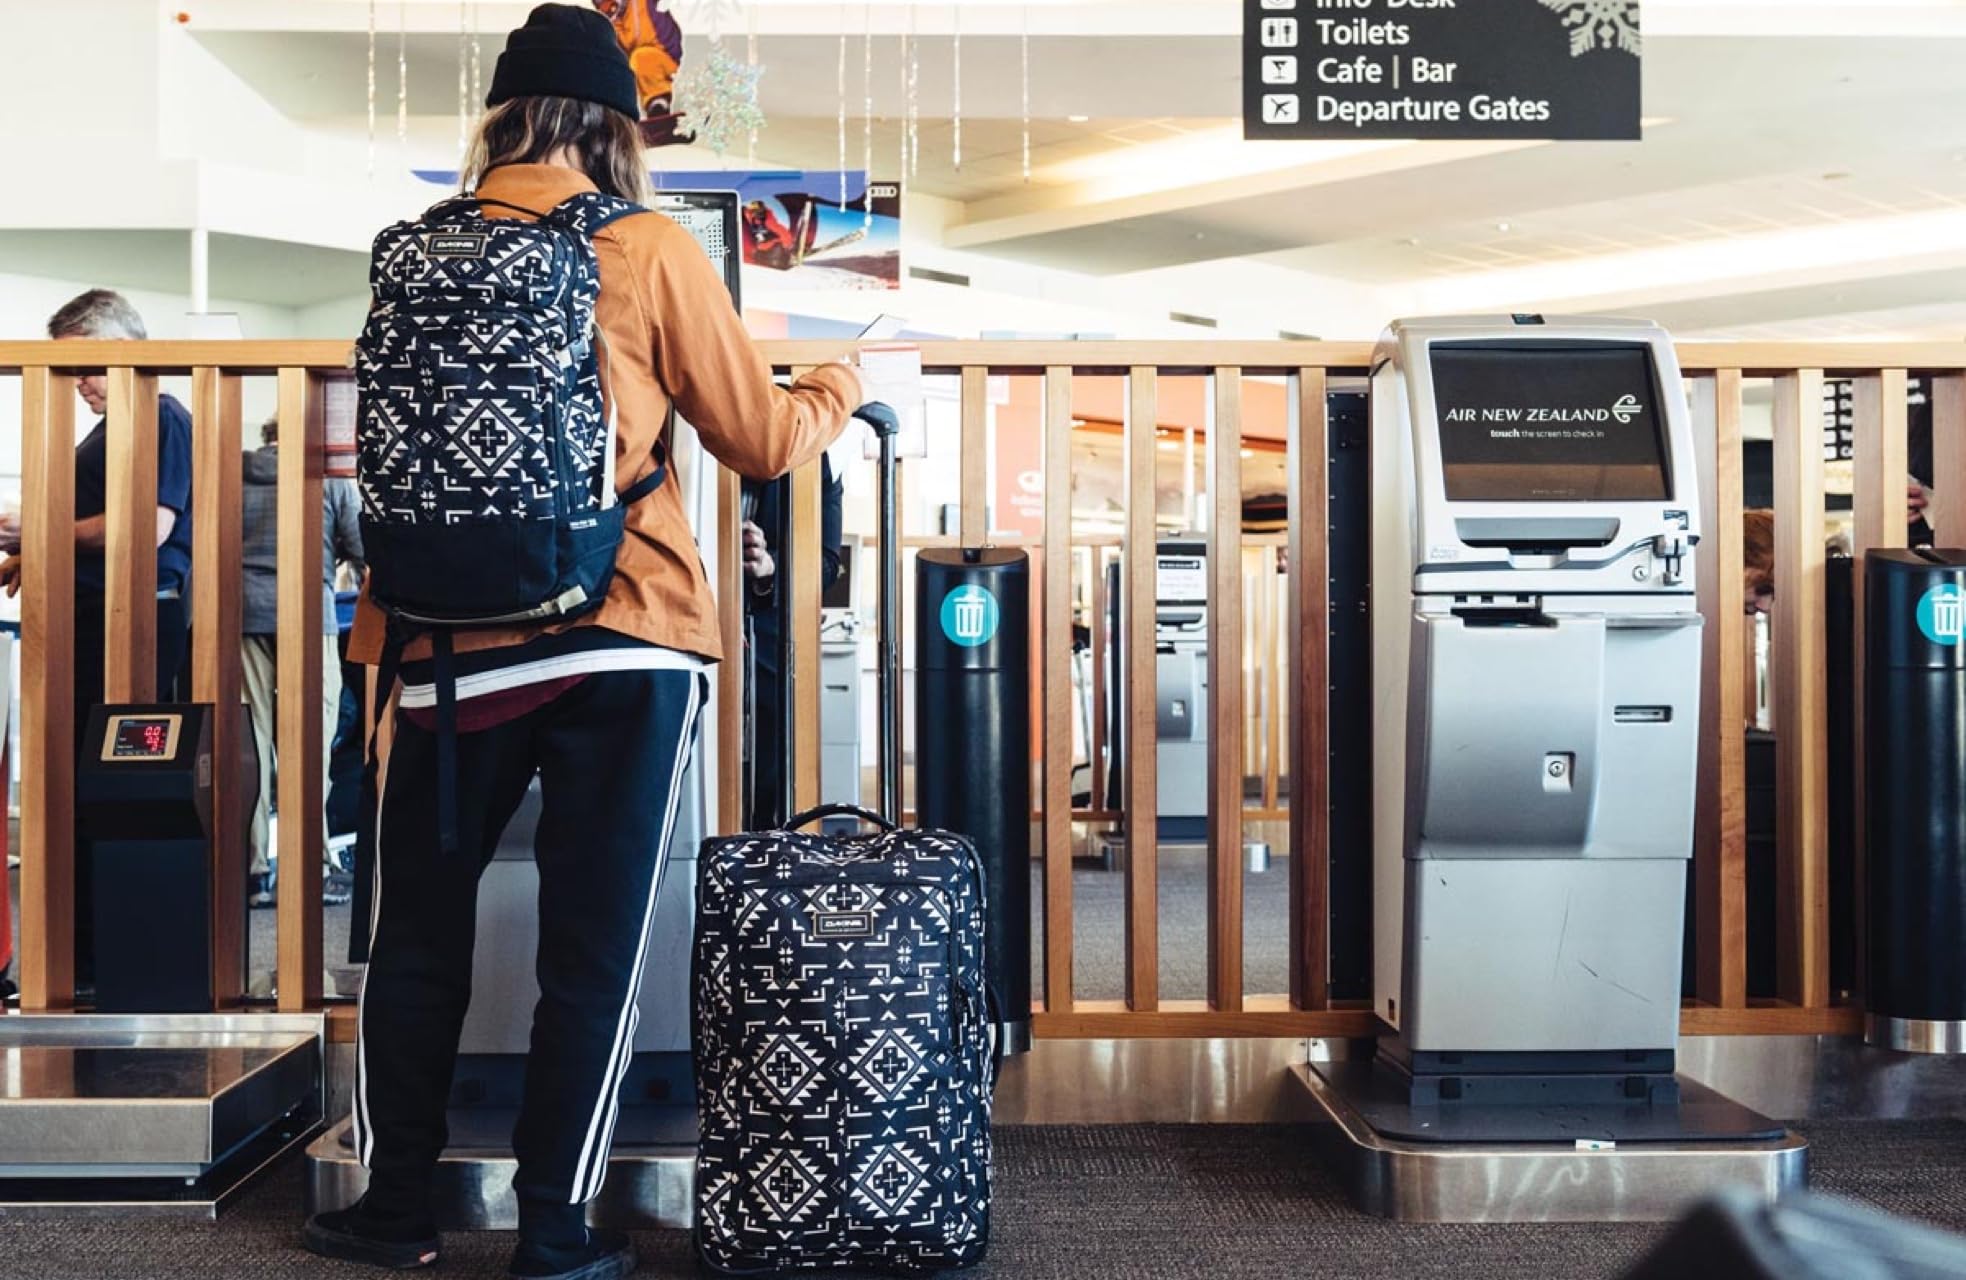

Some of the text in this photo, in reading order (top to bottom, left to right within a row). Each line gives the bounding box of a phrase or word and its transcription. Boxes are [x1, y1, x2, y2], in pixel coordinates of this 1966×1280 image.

[1316, 18, 1410, 45] Toilets
[1317, 56, 1457, 83] Cafe Bar
[1317, 95, 1550, 127] Departure Gates
[1445, 408, 1610, 421] AIR NEW ZEALAND
[1490, 428, 1520, 438] touch
